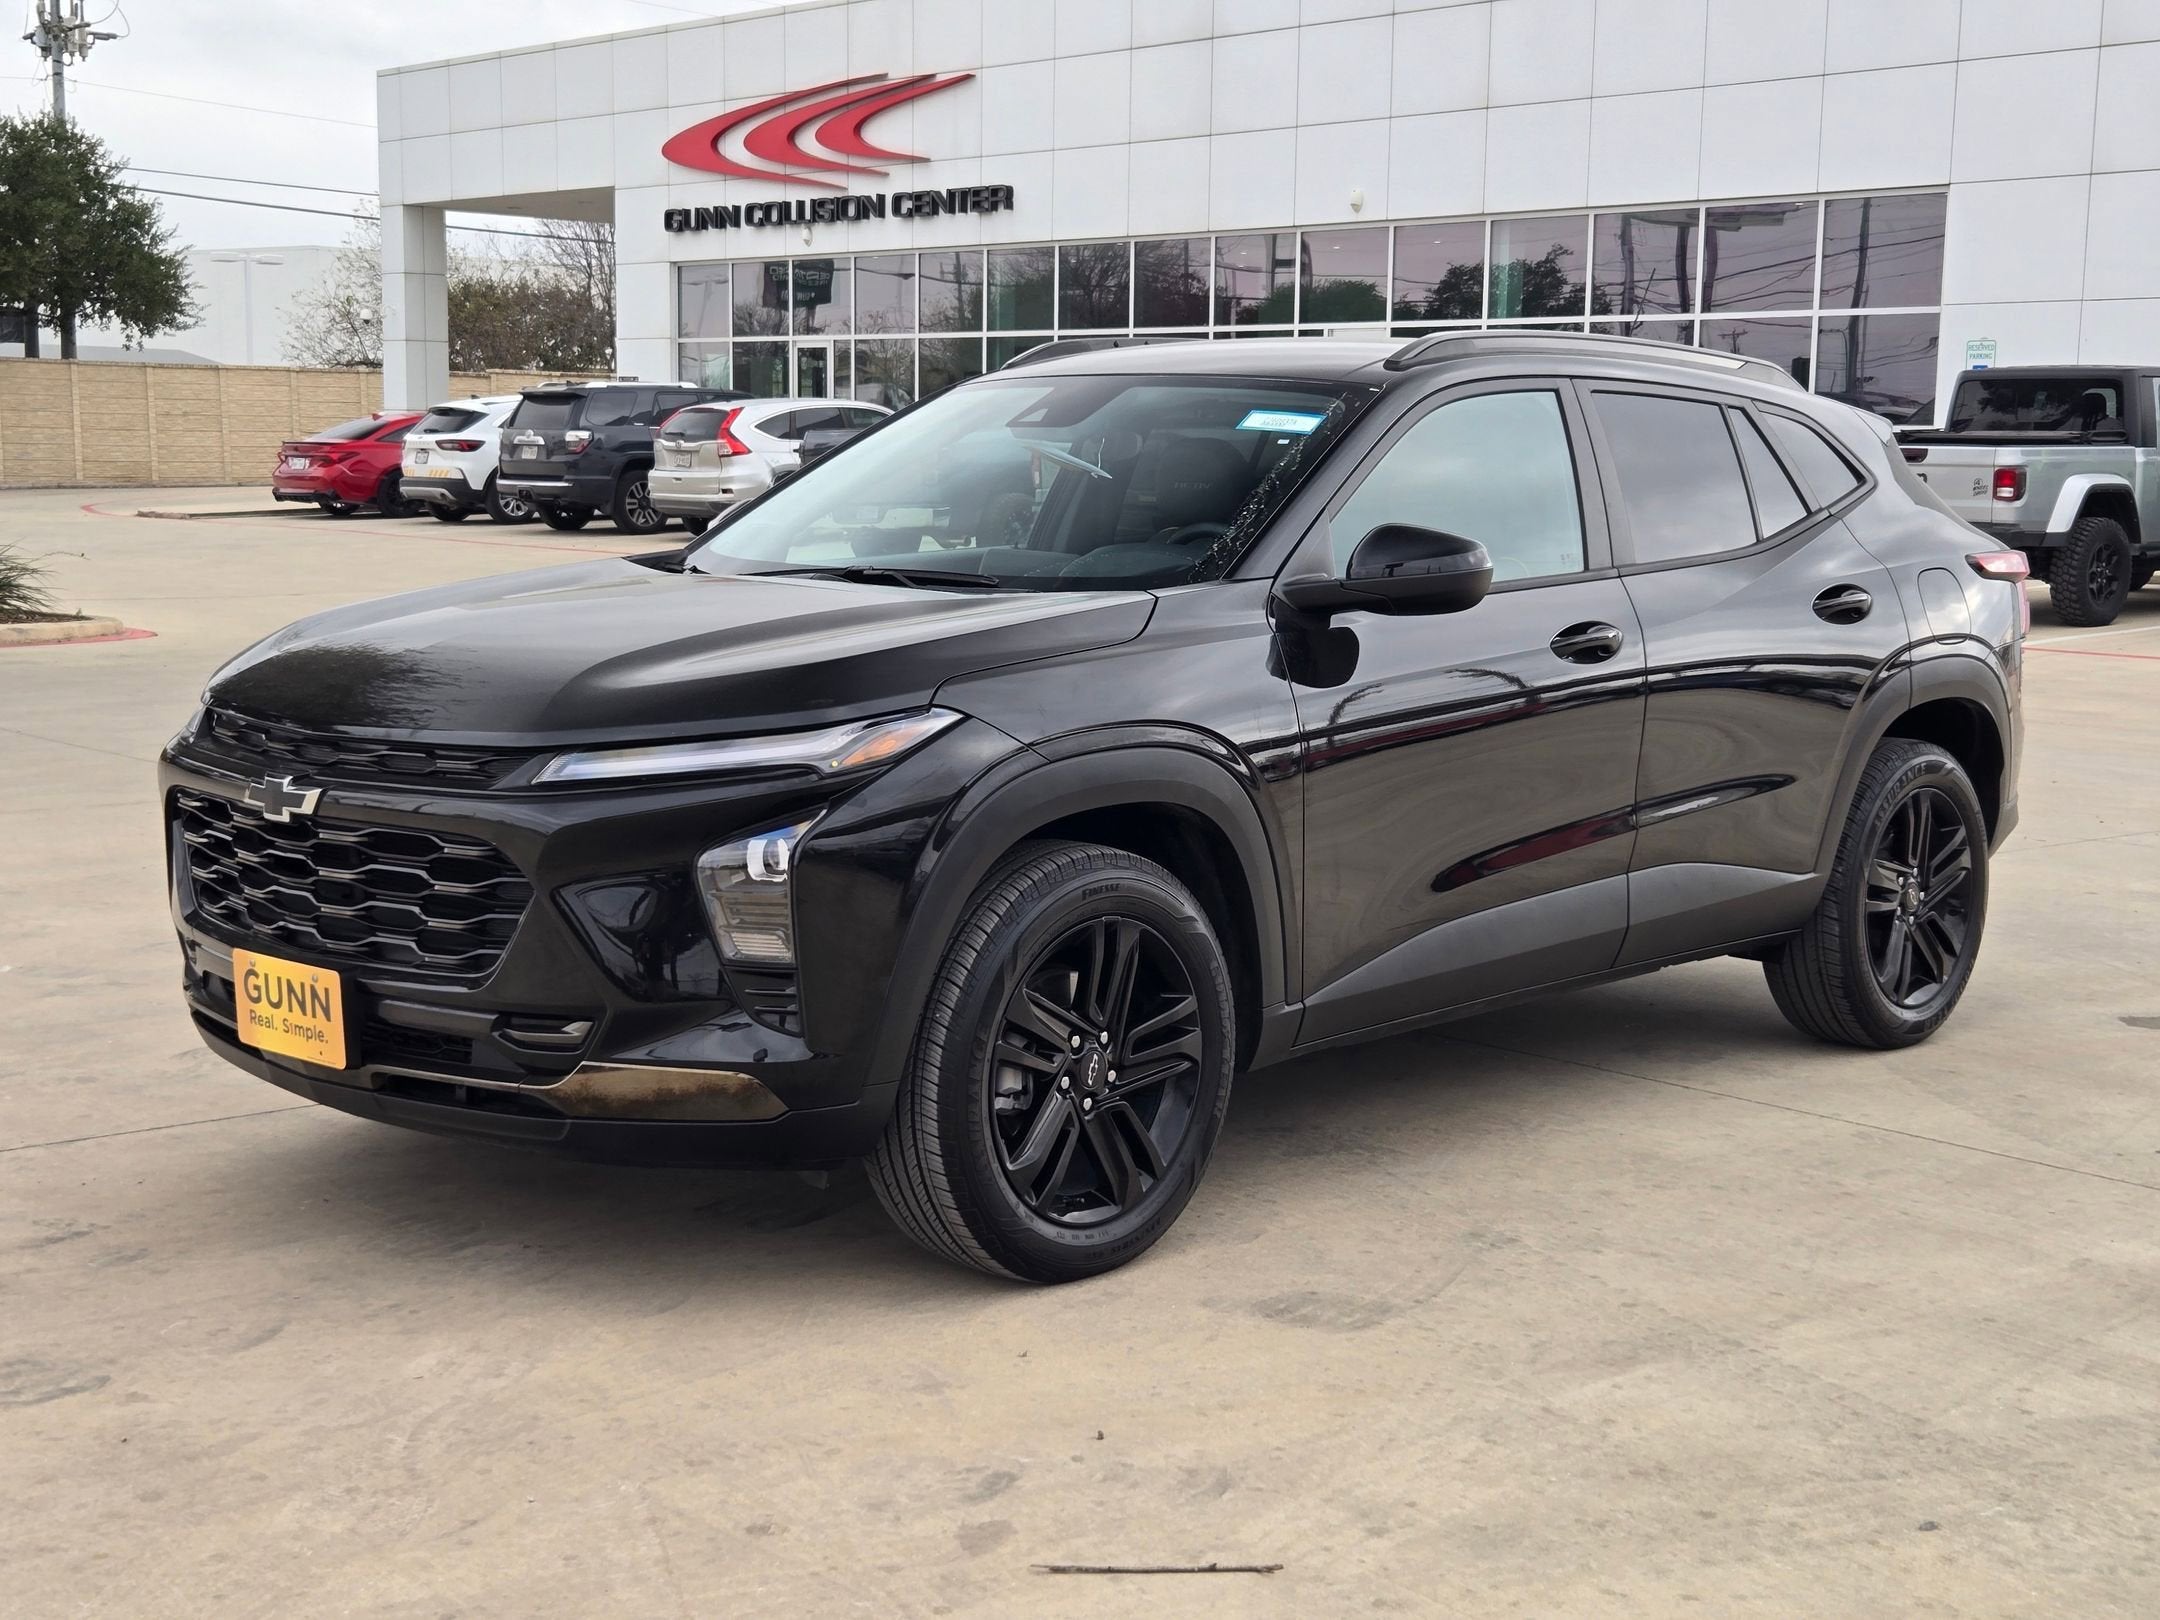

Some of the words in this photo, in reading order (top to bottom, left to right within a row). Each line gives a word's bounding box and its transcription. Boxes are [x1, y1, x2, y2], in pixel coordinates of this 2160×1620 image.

[664, 205, 741, 233] GUNN
[745, 193, 886, 228] COLLISION
[891, 184, 1014, 219] CENTER
[243, 968, 332, 1022] GUNN
[249, 1009, 278, 1031] Real.
[282, 1018, 329, 1044] Simple.
